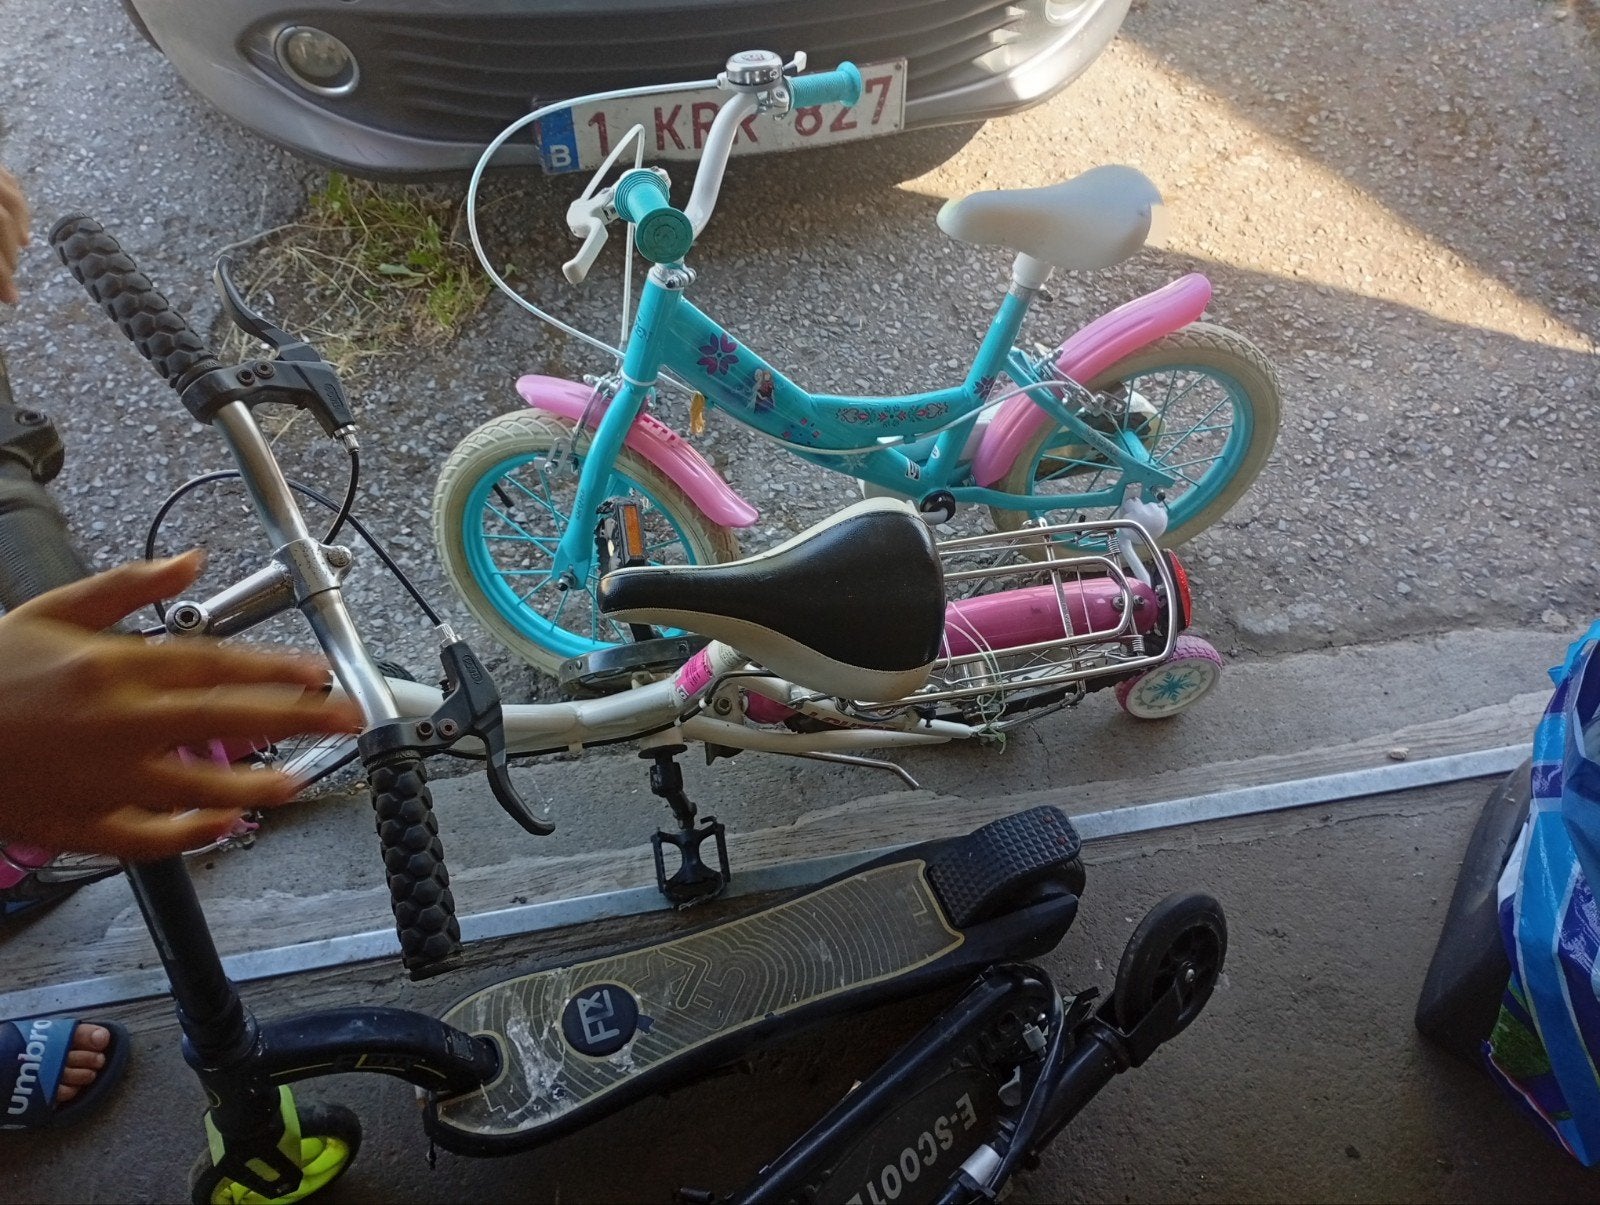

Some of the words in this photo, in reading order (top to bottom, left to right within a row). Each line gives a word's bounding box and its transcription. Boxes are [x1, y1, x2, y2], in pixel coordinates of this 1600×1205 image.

[551, 144, 571, 167] B
[588, 111, 611, 157] 1
[795, 75, 892, 136] 827
[7, 1020, 52, 1115] umbro
[845, 1092, 978, 1205] E-SCOOT
